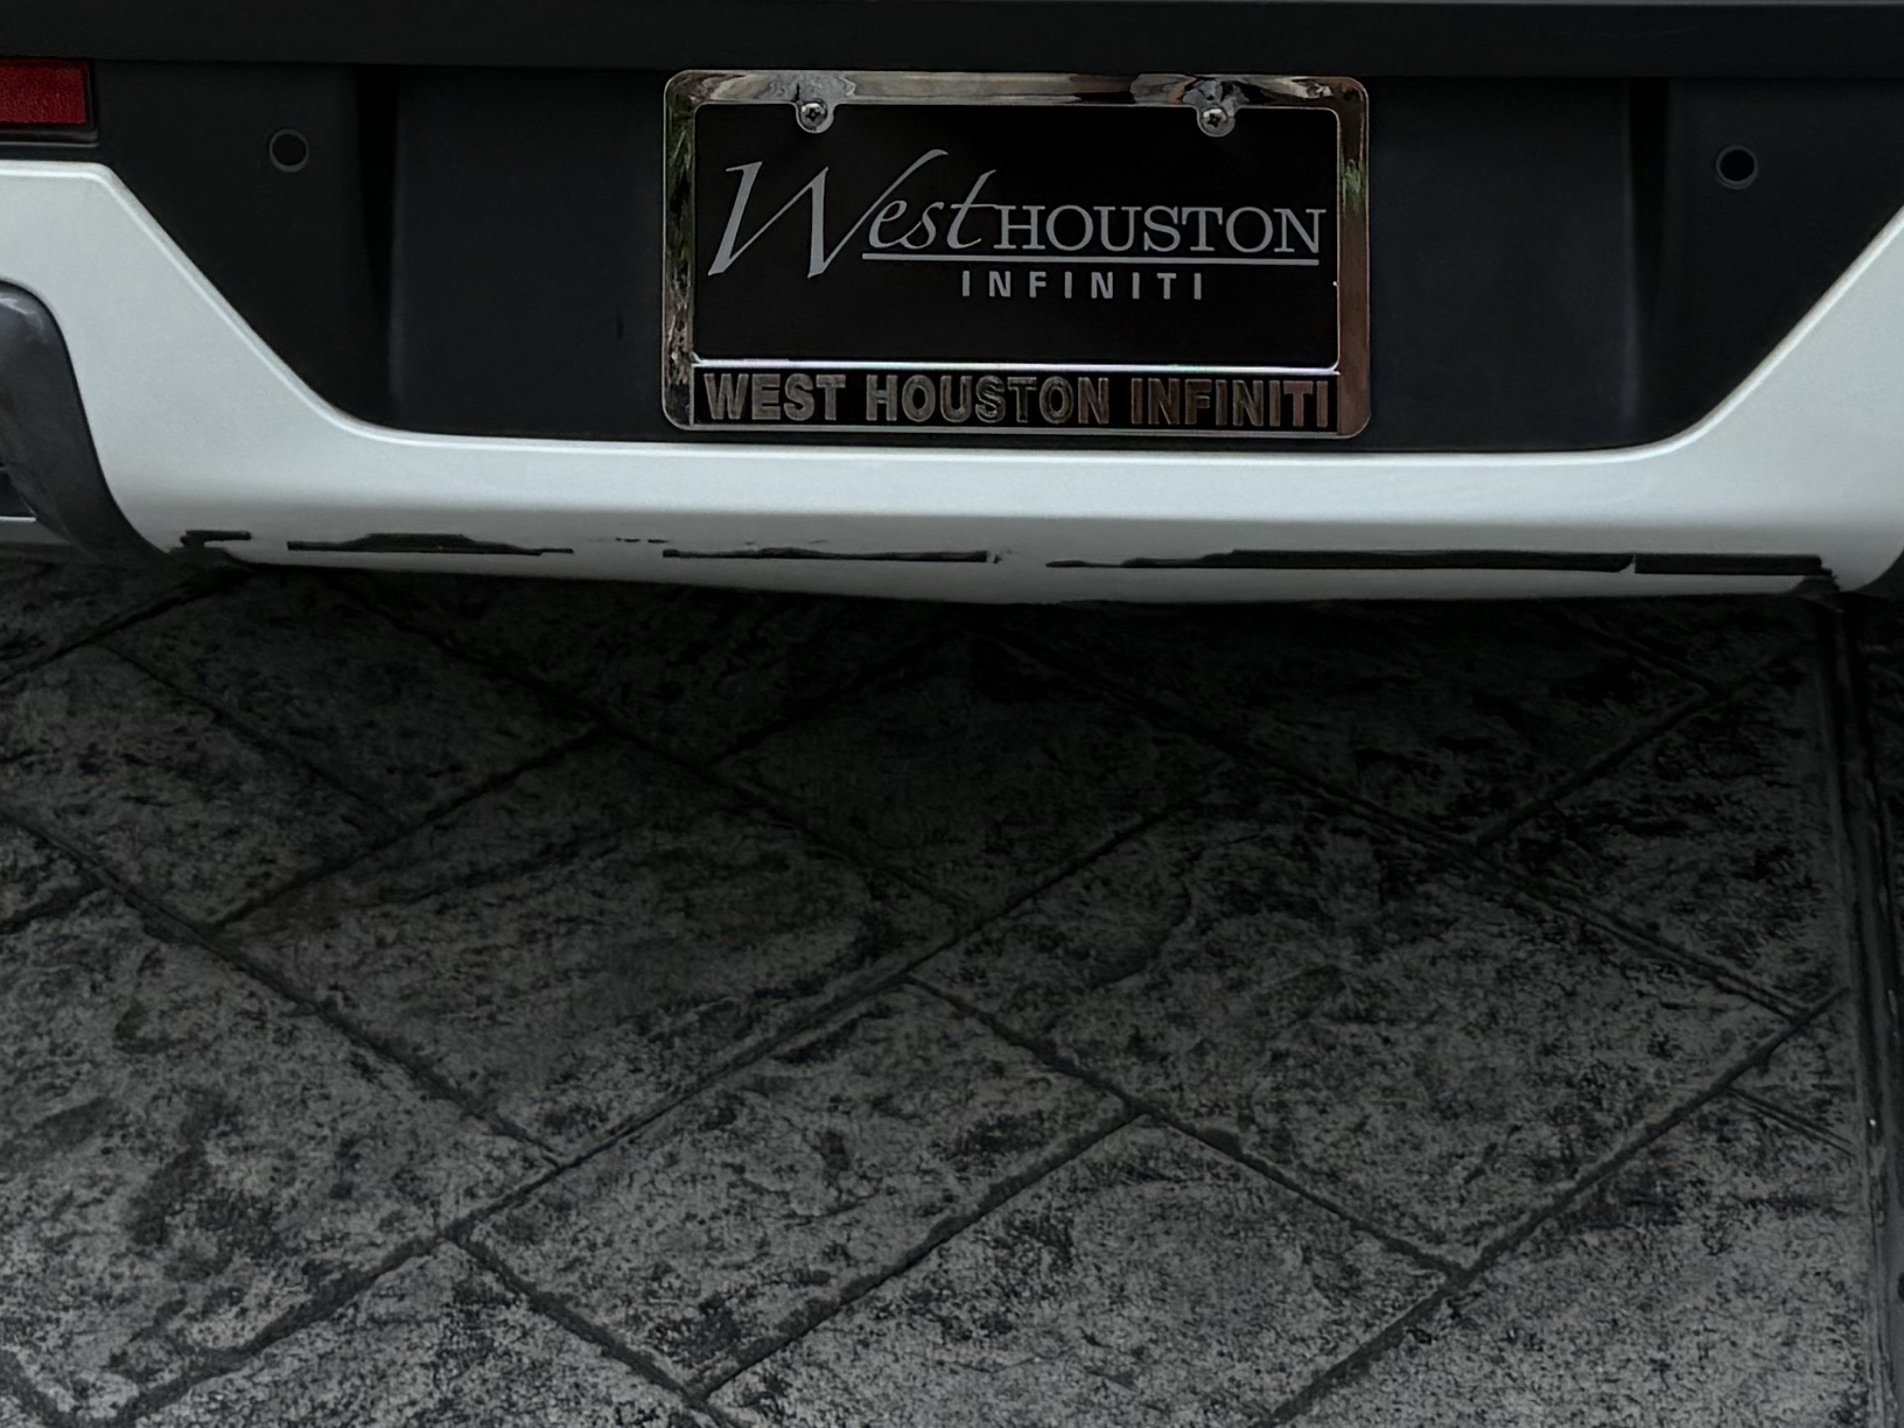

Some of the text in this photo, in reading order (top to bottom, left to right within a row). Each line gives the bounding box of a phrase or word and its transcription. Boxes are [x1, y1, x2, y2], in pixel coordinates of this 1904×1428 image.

[707, 148, 1328, 279] West HOUSTON
[962, 270, 1203, 300] INFINITI
[703, 372, 1329, 428] WEST HOUSTON INFINITI
